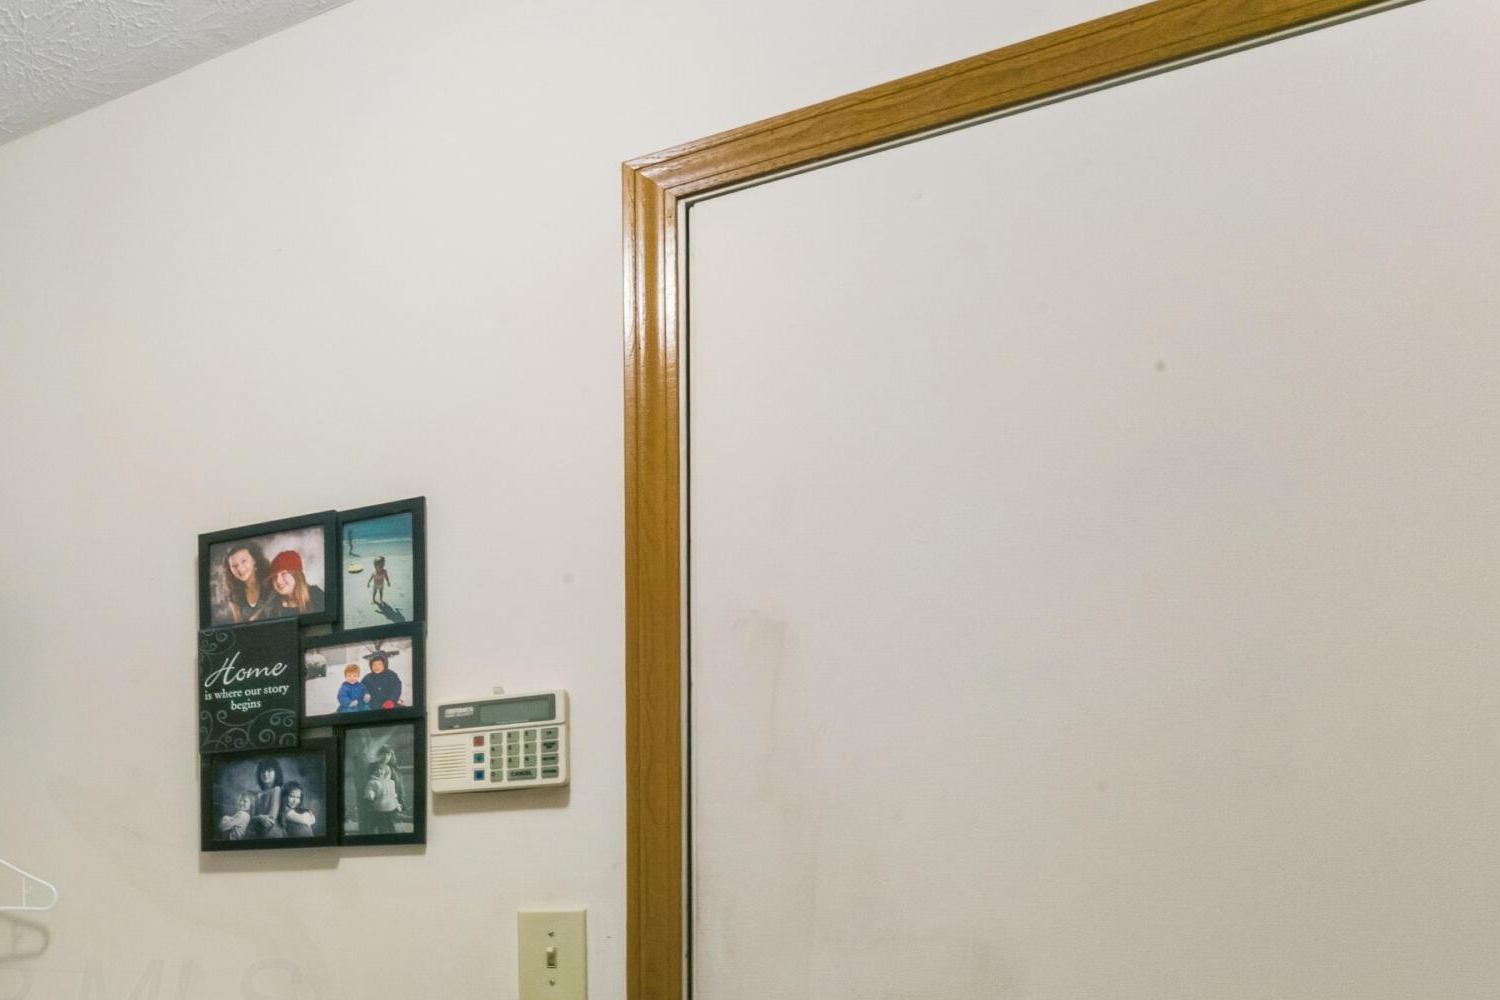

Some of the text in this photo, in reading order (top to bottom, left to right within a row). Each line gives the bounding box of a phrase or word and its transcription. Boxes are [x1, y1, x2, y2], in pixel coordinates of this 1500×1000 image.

[204, 651, 288, 687] Home
[204, 685, 290, 701] is where our story
[230, 699, 262, 712] begins
